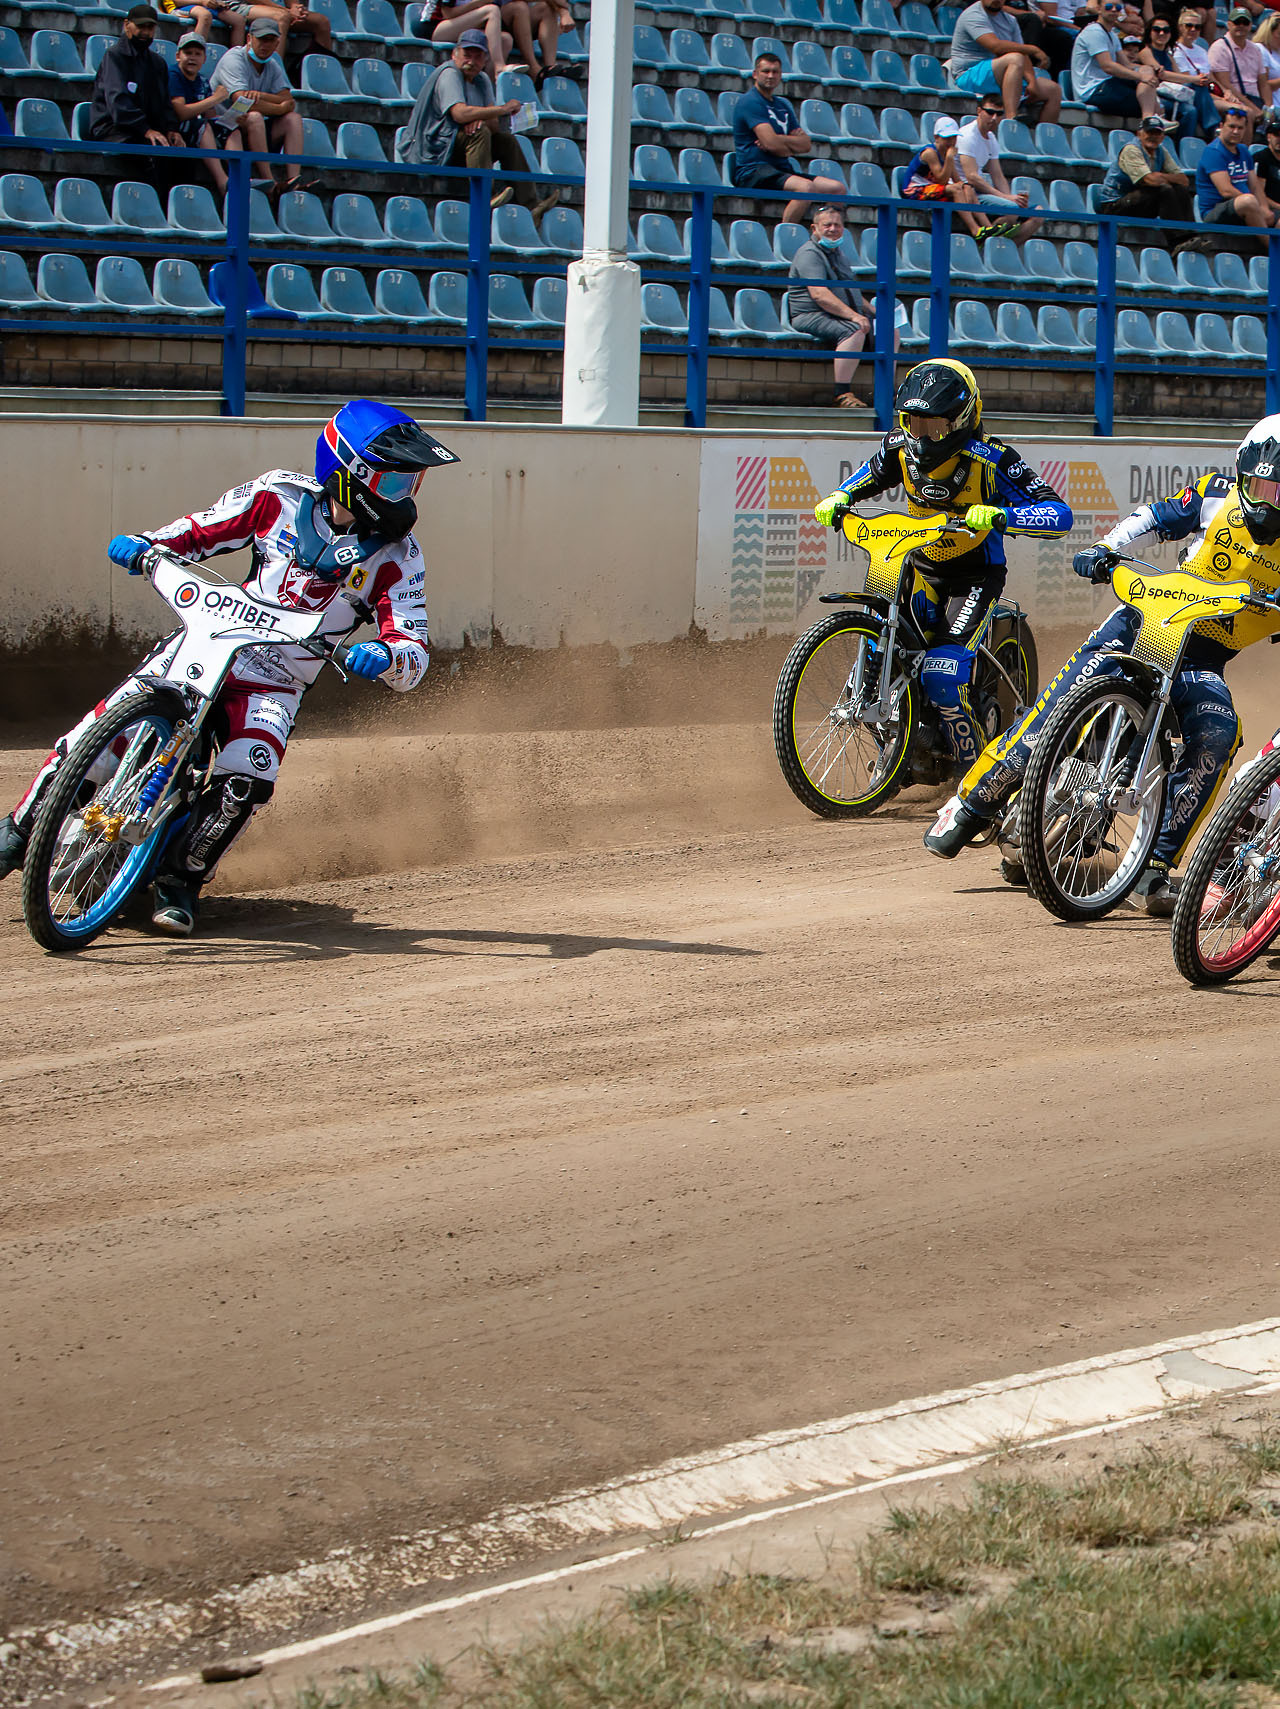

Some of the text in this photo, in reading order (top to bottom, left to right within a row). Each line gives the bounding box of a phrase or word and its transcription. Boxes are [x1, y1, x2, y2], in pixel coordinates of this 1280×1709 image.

[870, 527, 927, 540] spechouse
[205, 591, 280, 629] OPTIBET
[1147, 587, 1221, 607] spechouse
[938, 705, 978, 762] MOST
